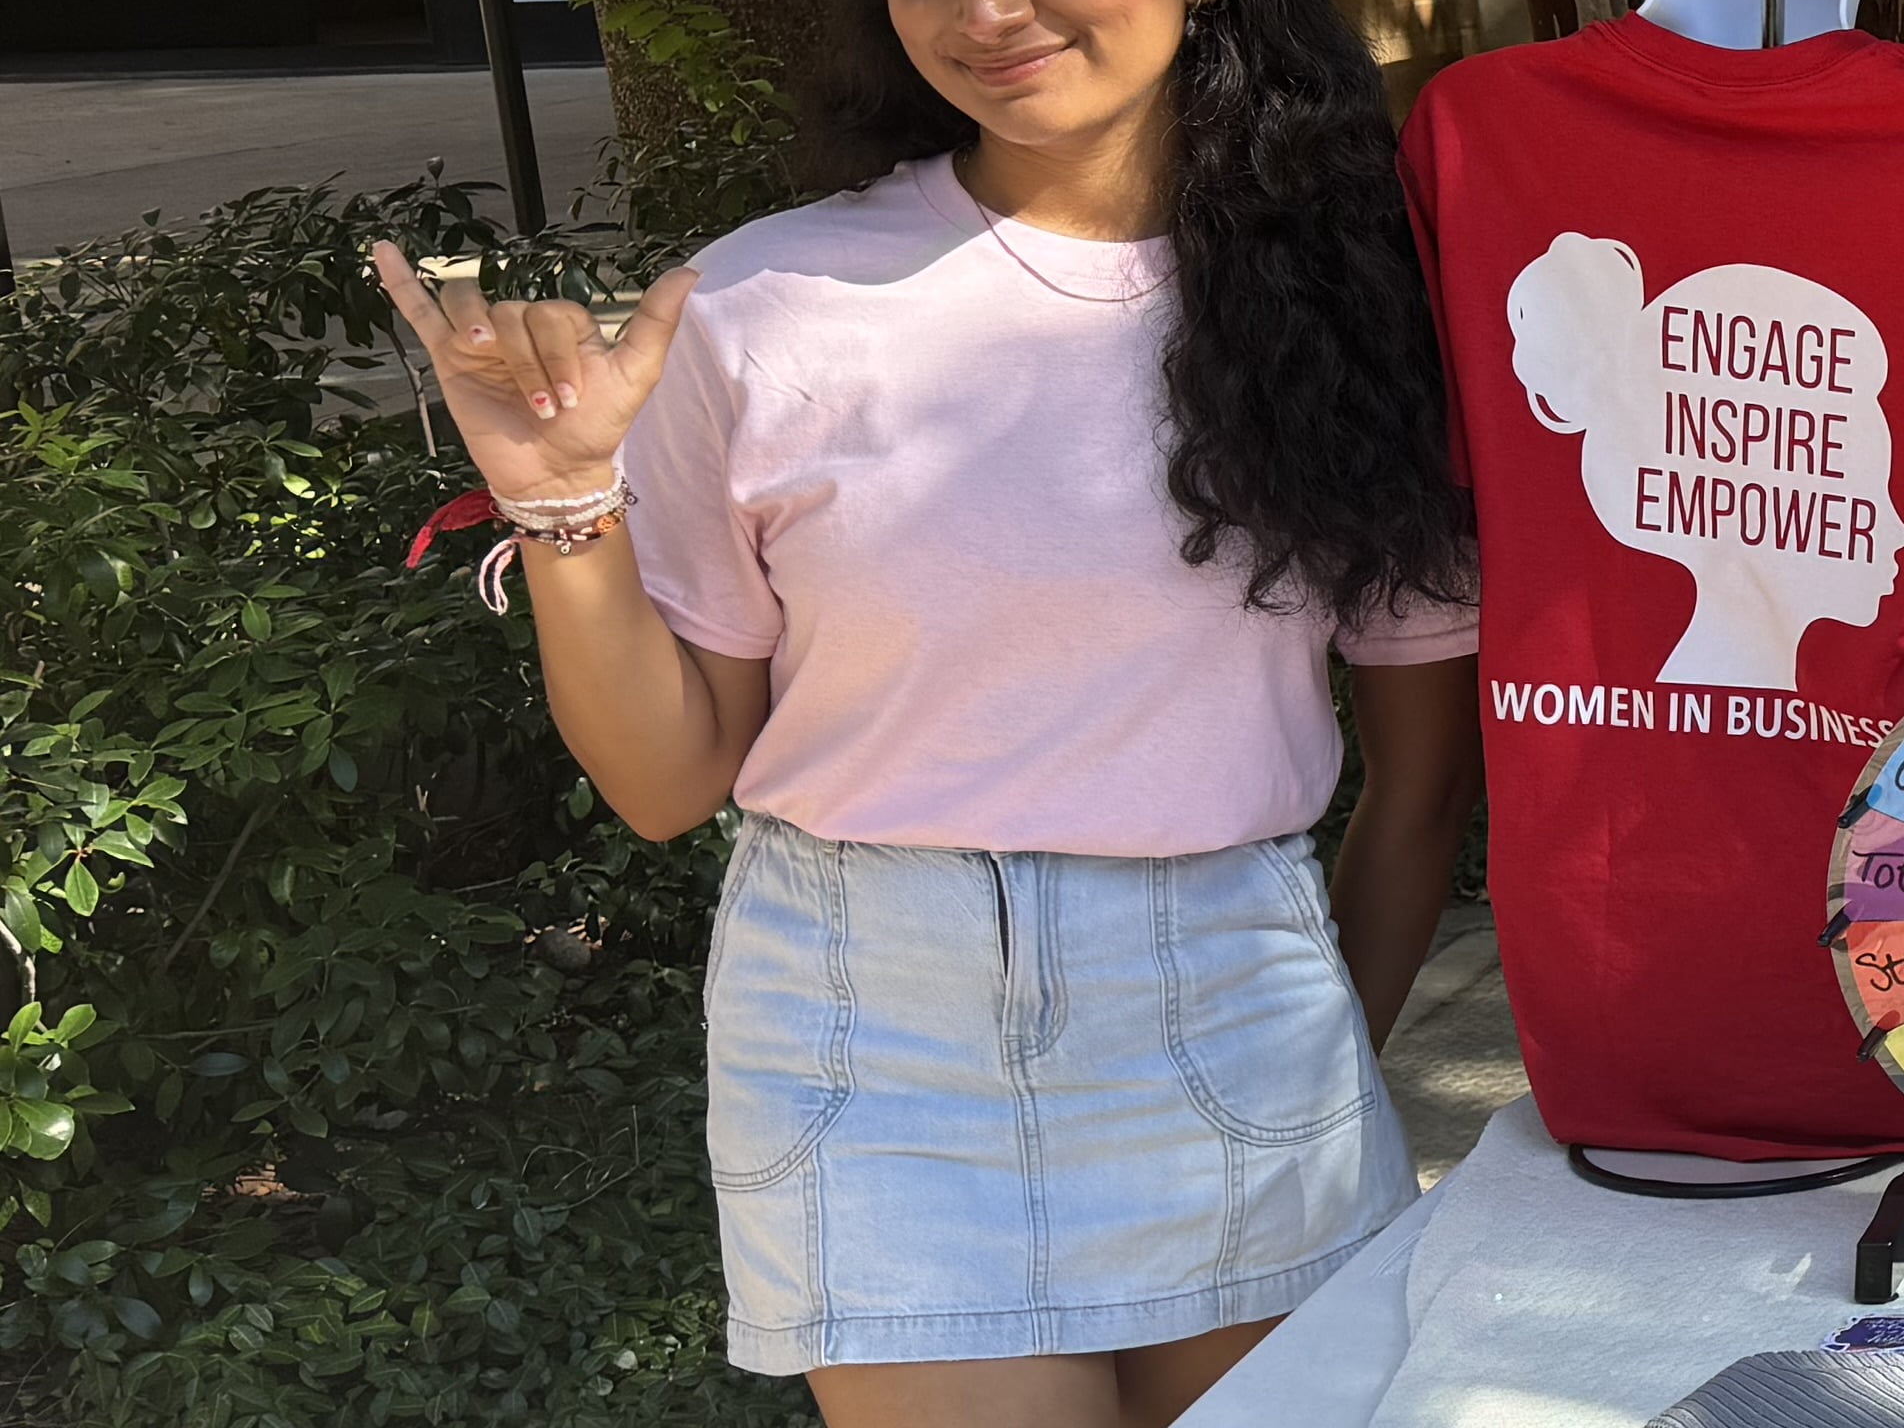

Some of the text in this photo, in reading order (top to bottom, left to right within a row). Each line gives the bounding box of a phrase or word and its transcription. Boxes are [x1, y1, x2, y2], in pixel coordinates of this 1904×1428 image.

[1662, 305, 1856, 395] ENGAGE
[1665, 391, 1848, 479] INSPIRE
[1635, 467, 1877, 564] EMPOWER
[1490, 679, 1892, 750] WOMEN IN BUSINESS
